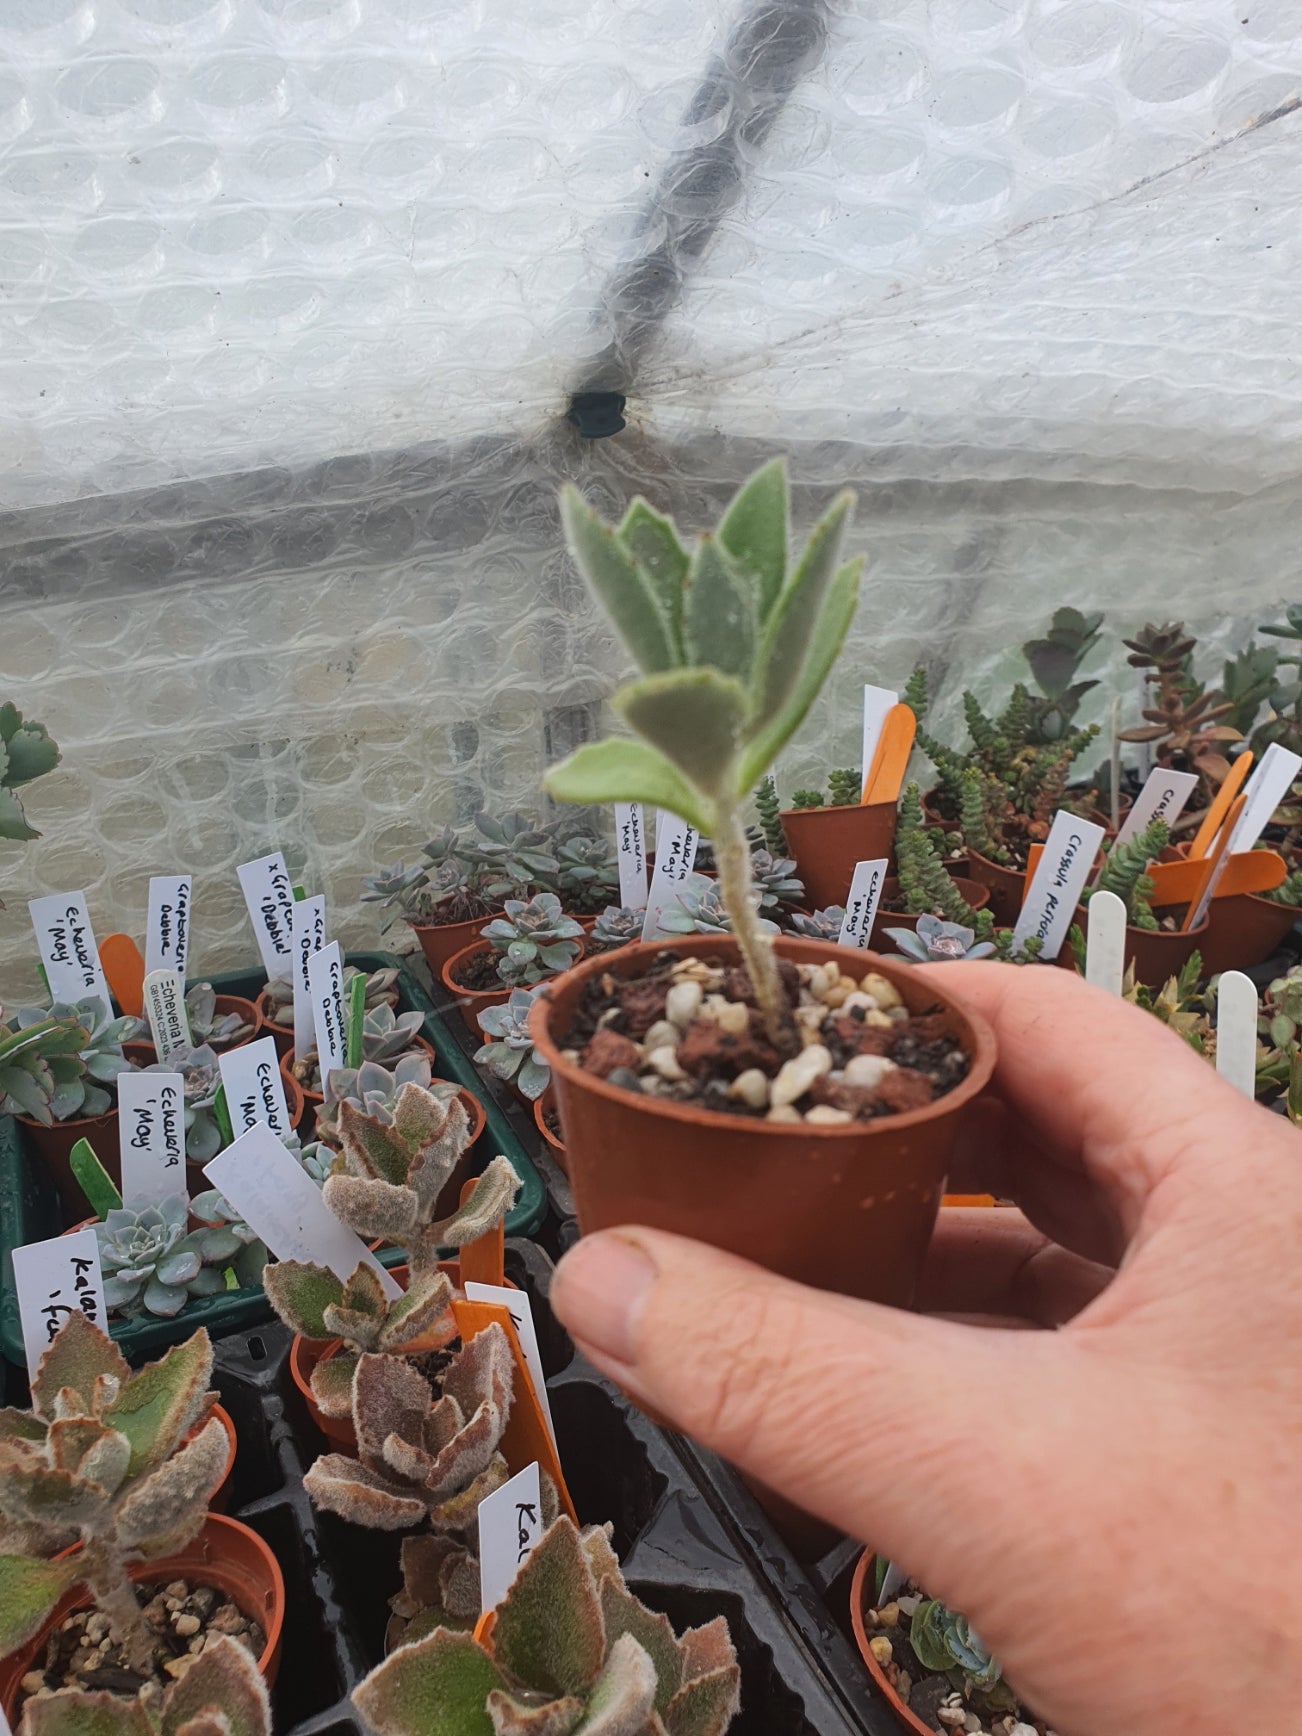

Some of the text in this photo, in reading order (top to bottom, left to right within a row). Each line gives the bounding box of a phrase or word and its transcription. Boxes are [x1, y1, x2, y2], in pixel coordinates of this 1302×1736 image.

[1053, 834, 1082, 888] Crassula
[66, 906, 99, 988] Echeveria
[160, 904, 172, 957] Debbie
[160, 979, 183, 1039] Echeveria
[322, 997, 336, 1057] Debbie
[161, 1087, 181, 1169] Echeveria
[240, 1095, 257, 1134] 'Ma
